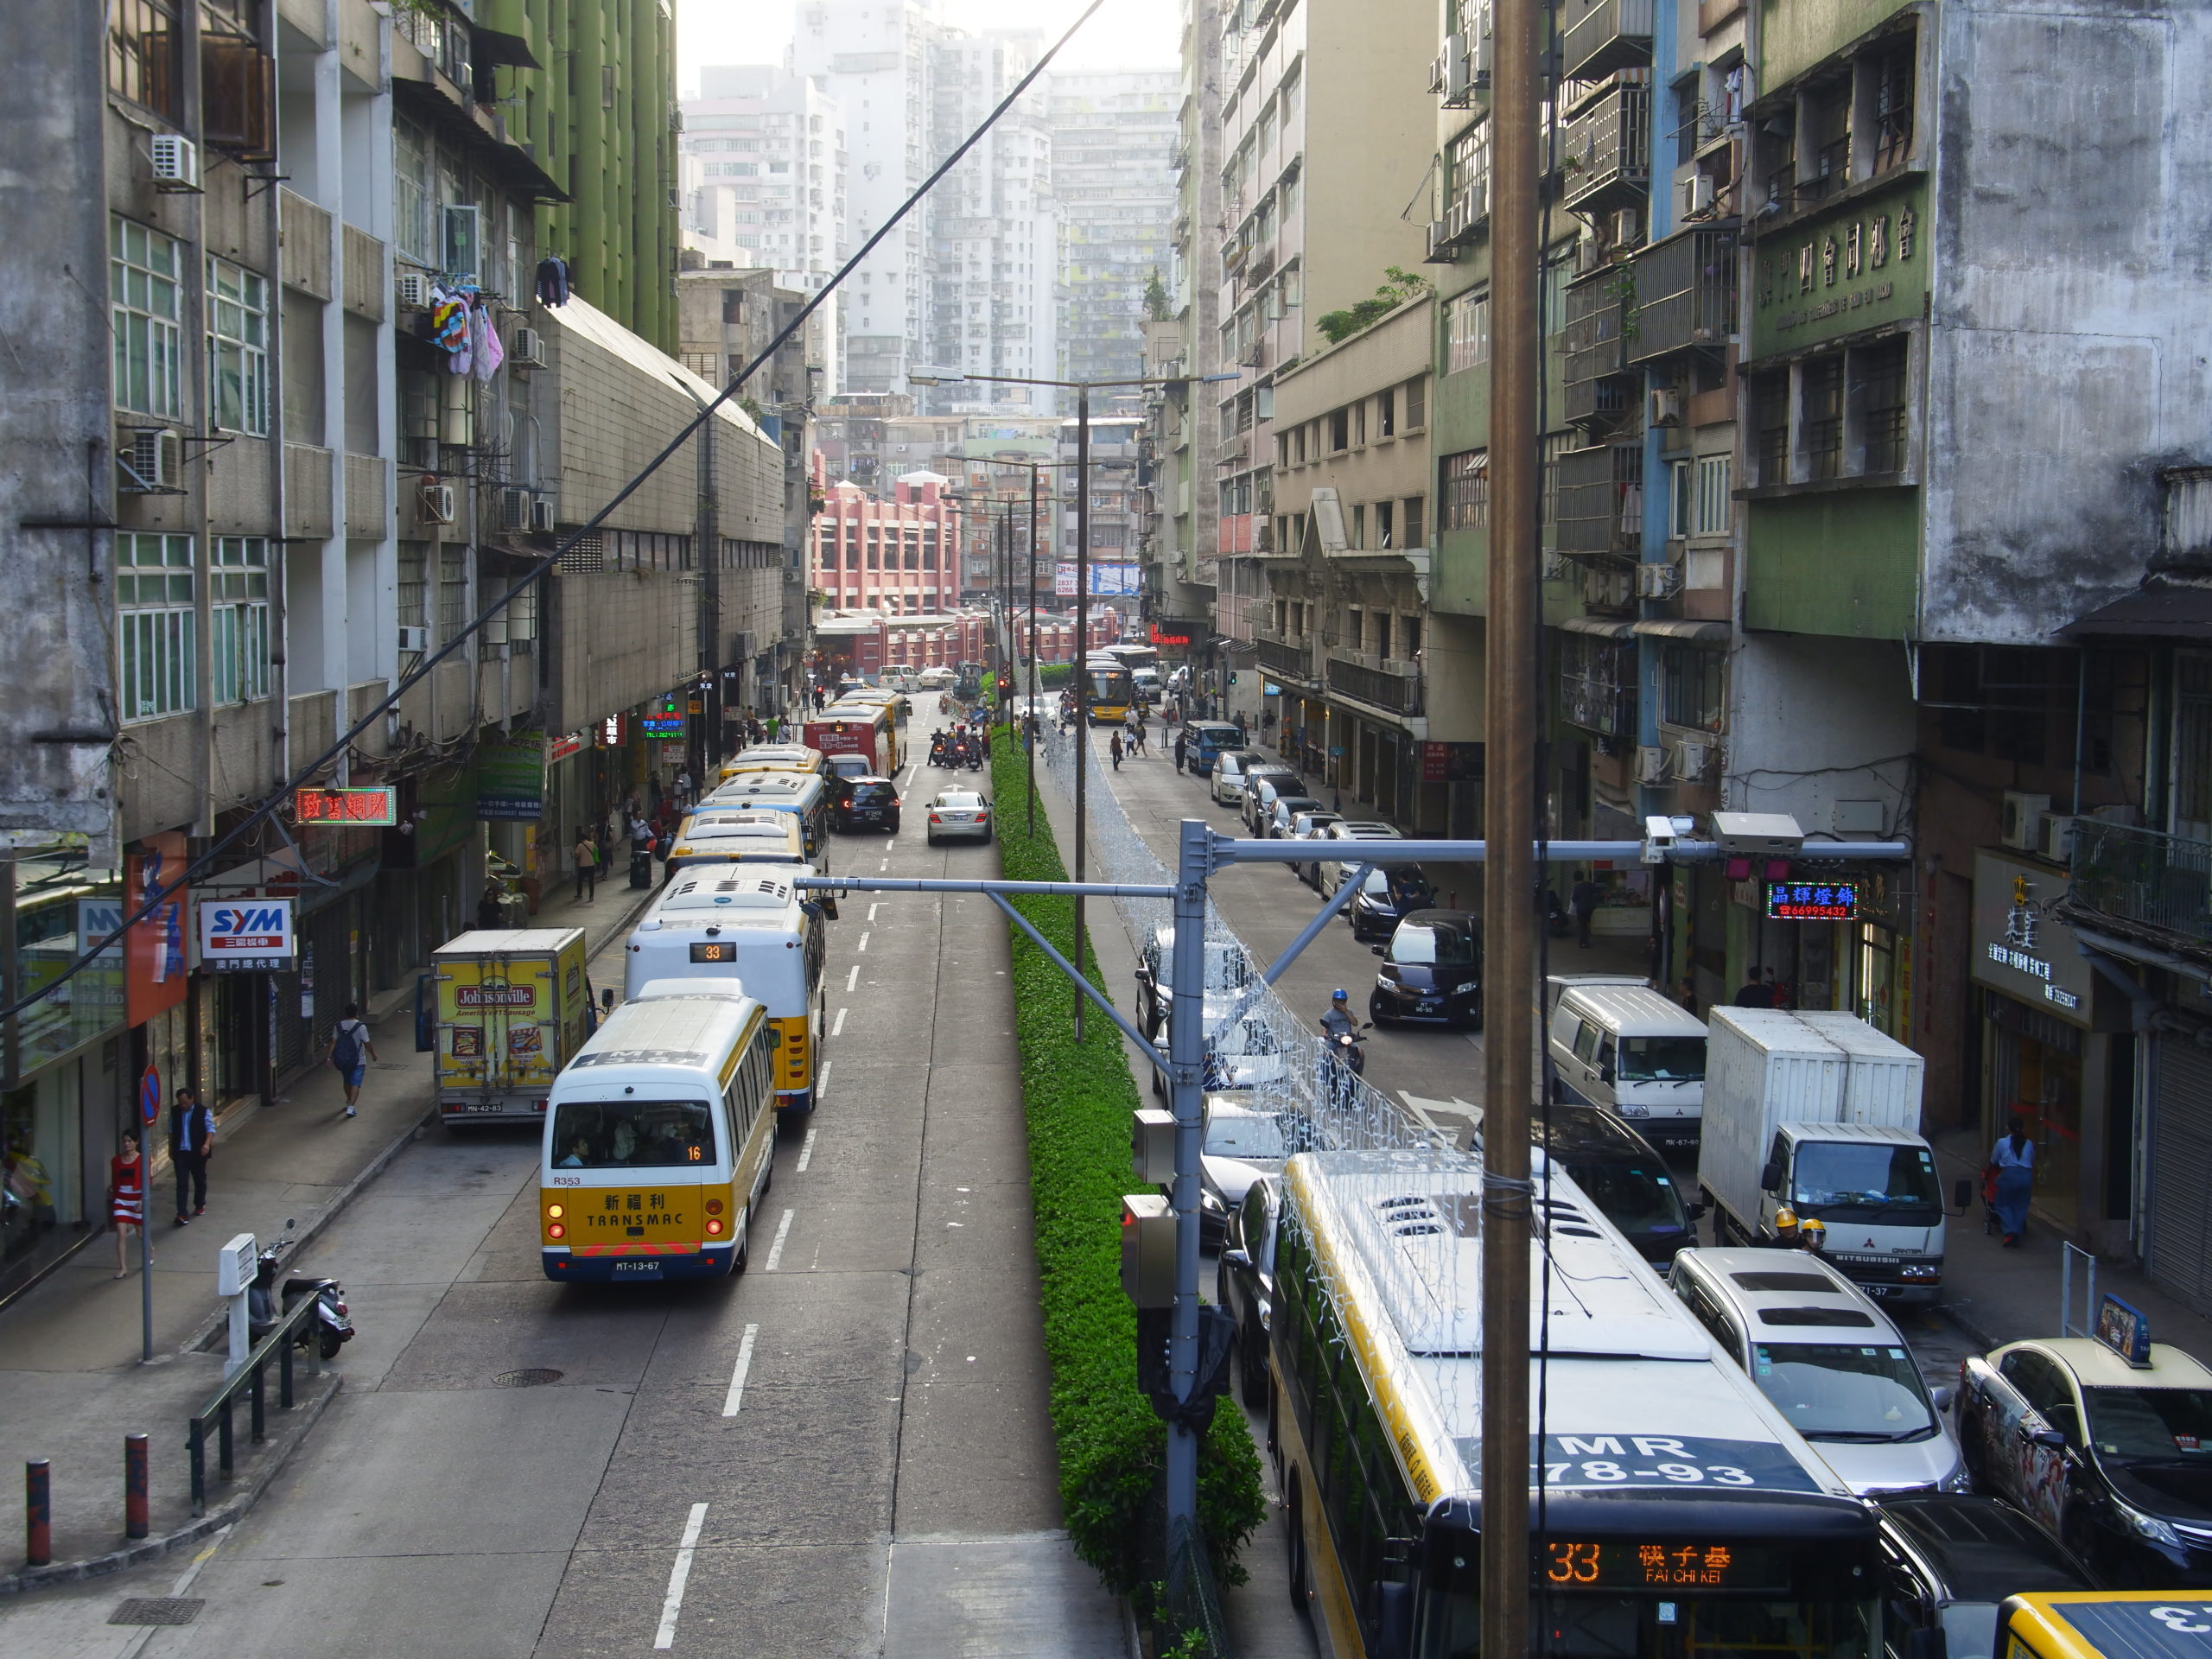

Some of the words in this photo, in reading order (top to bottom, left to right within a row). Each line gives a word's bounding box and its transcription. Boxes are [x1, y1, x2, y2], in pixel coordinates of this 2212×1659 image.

[1772, 886, 1853, 906] 晶輝燈飾
[1792, 906, 1846, 916] 66995432
[211, 909, 283, 935] SYM
[706, 945, 720, 959] 33
[216, 959, 280, 969] 澳門總代理
[460, 990, 530, 1005] Johnsonville
[688, 1146, 701, 1160] 16
[605, 1194, 664, 1211] 新福利
[588, 1213, 683, 1226] TRANSMAC
[616, 1262, 659, 1270] MT-13-67
[1836, 1255, 1900, 1264] MITSUBISHI
[1557, 1437, 1697, 1458] MR
[1529, 1461, 1755, 1485] 78-93
[1548, 1543, 1599, 1582] 33
[1639, 1544, 1730, 1567] 筷子基
[1646, 1569, 1669, 1583] FAI
[1674, 1569, 1695, 1583] CHI
[1700, 1569, 1720, 1583] KEI
